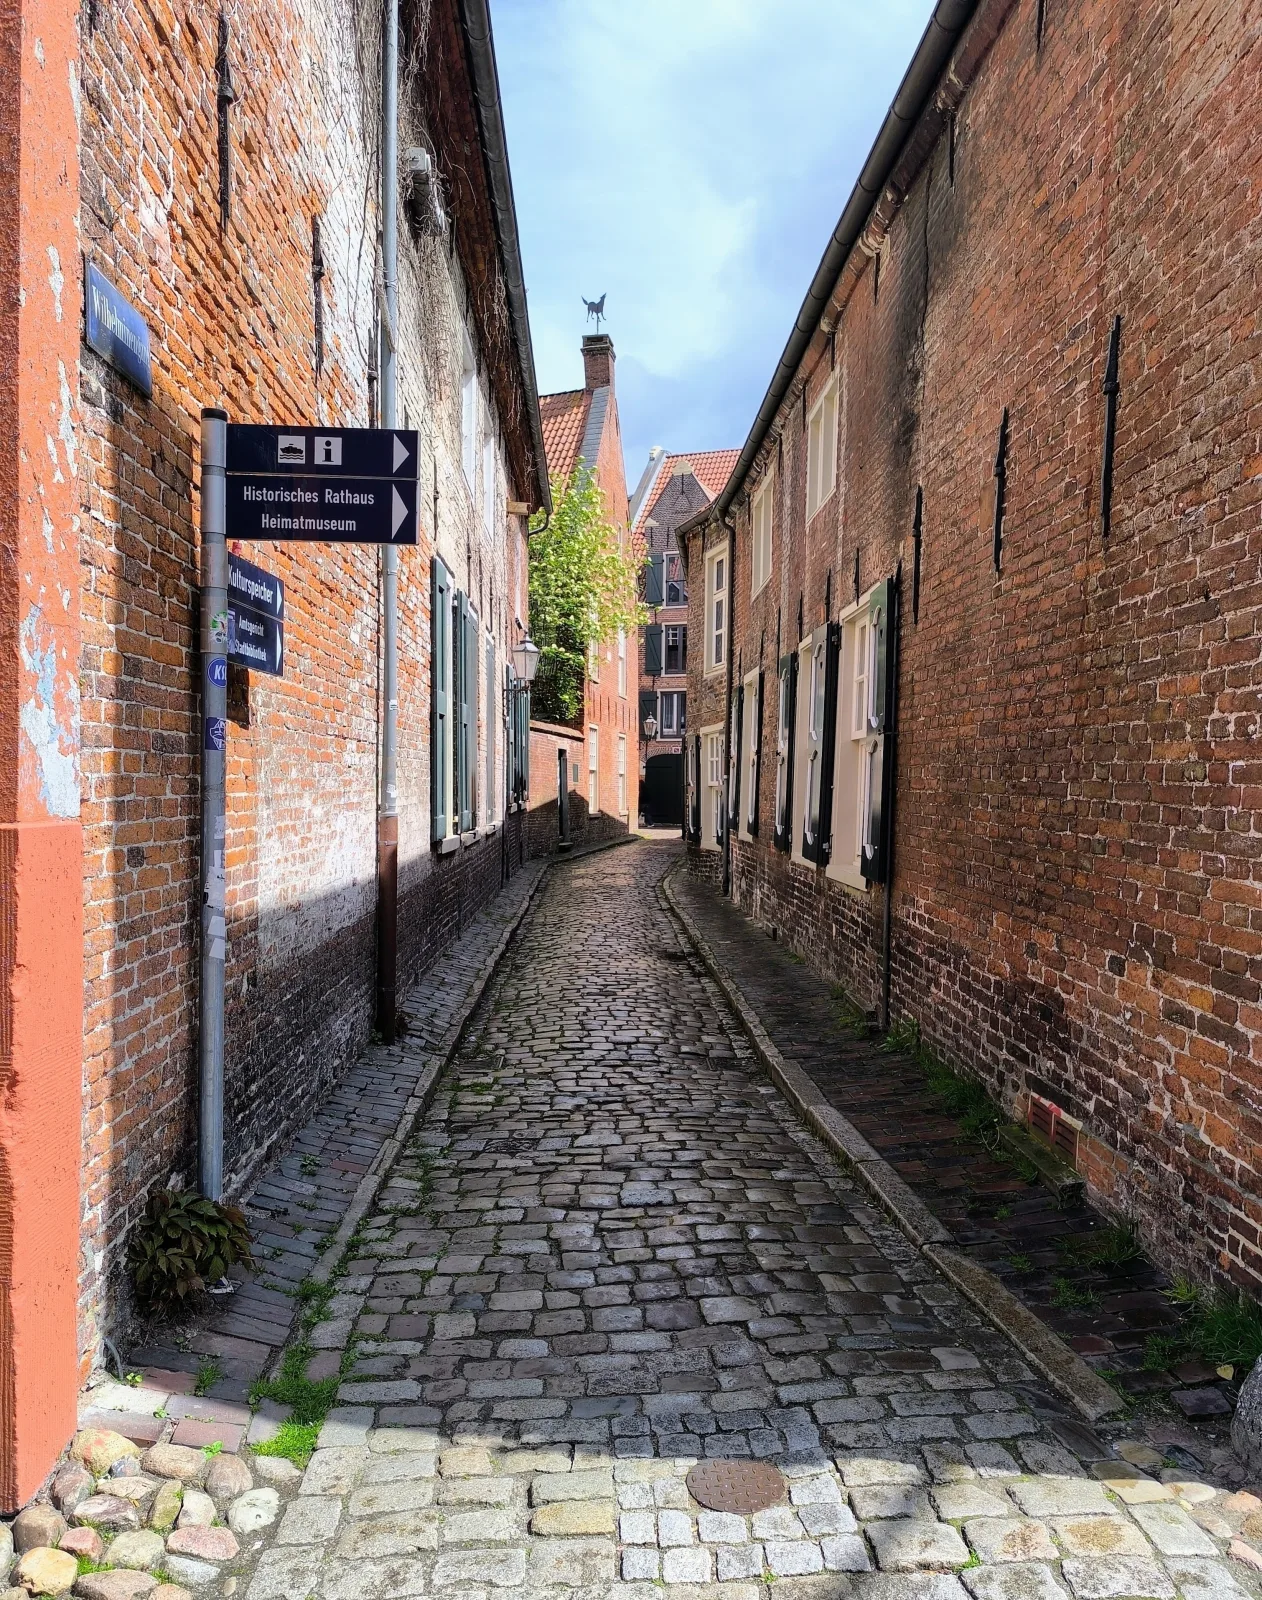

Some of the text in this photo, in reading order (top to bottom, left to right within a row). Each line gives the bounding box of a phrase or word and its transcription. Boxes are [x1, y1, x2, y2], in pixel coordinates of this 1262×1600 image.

[243, 486, 375, 505] Historisches Rathaus
[261, 513, 357, 531] Heimatmuseum
[228, 563, 273, 604] Kulturspeicher
[238, 614, 264, 637] Amtsgericht
[235, 638, 267, 662] Stadtbibliothek
